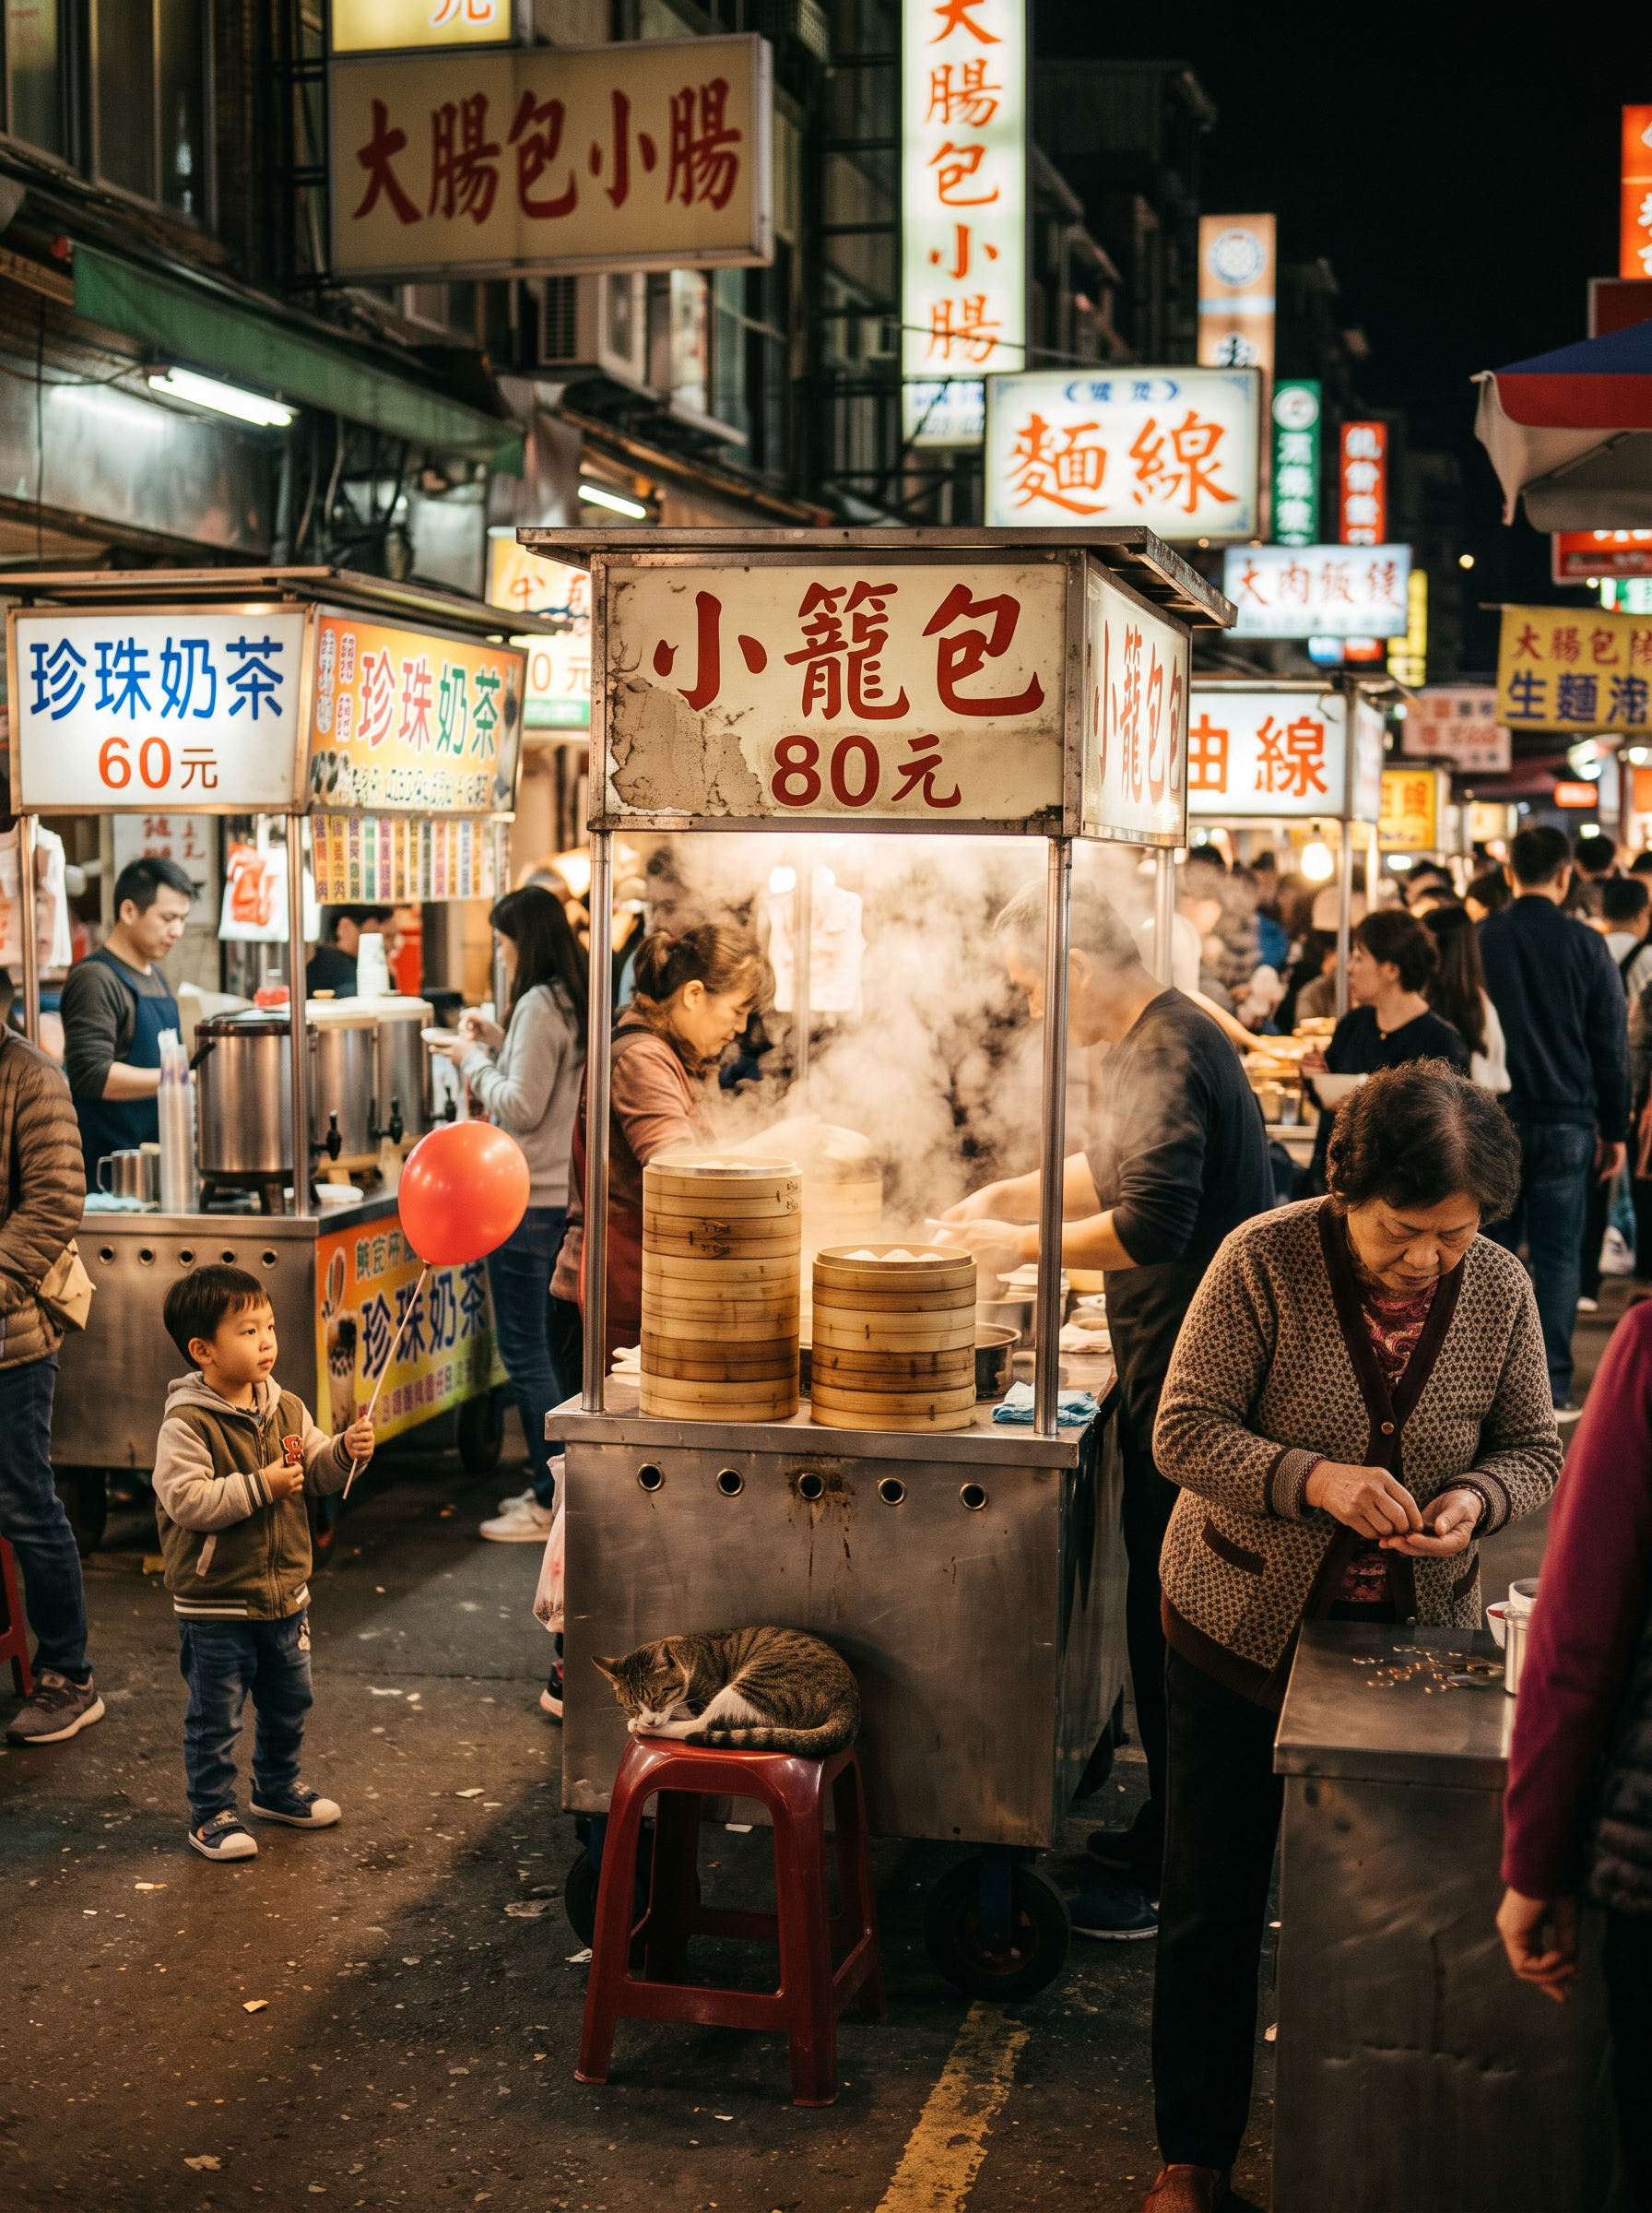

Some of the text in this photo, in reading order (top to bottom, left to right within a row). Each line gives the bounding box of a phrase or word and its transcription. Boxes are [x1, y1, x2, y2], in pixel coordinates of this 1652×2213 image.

[353, 77, 741, 225] 大腸包小腸
[926, 0, 1003, 363] 大腸包小腸
[1007, 411, 1238, 515] 麵線
[30, 636, 283, 720] 珍珠奶茶
[358, 647, 502, 760] 珍珠奶茶
[653, 581, 1045, 720] 小籠包
[98, 737, 218, 790] 60元
[771, 734, 962, 808] 80元
[360, 1263, 486, 1379] 珍珠奶茶
